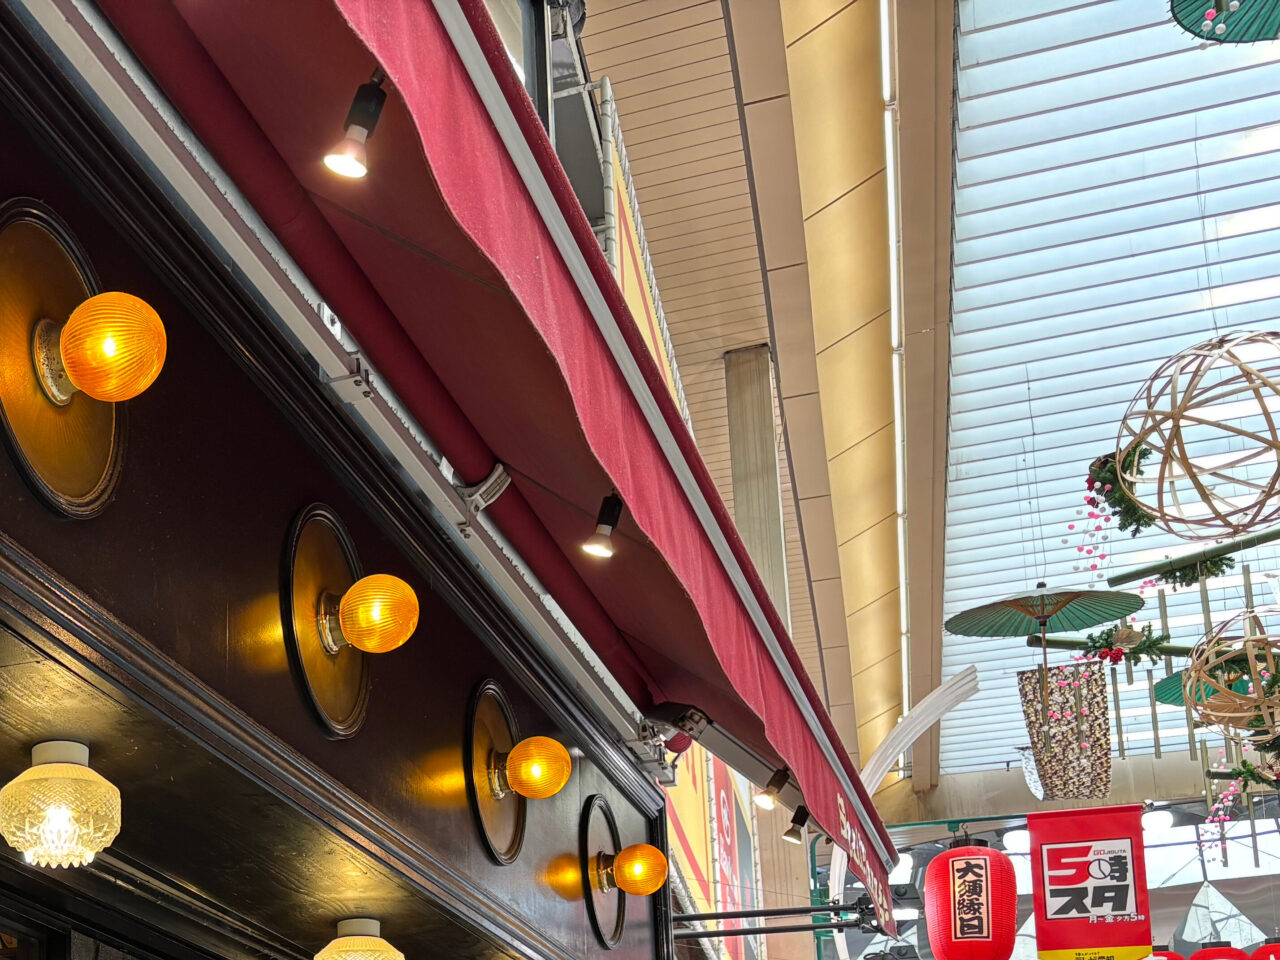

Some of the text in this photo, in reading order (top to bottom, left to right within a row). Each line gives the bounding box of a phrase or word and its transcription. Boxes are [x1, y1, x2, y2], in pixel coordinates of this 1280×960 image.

[956, 860, 984, 937] 大須縁日
[1049, 884, 1129, 916] スタ
